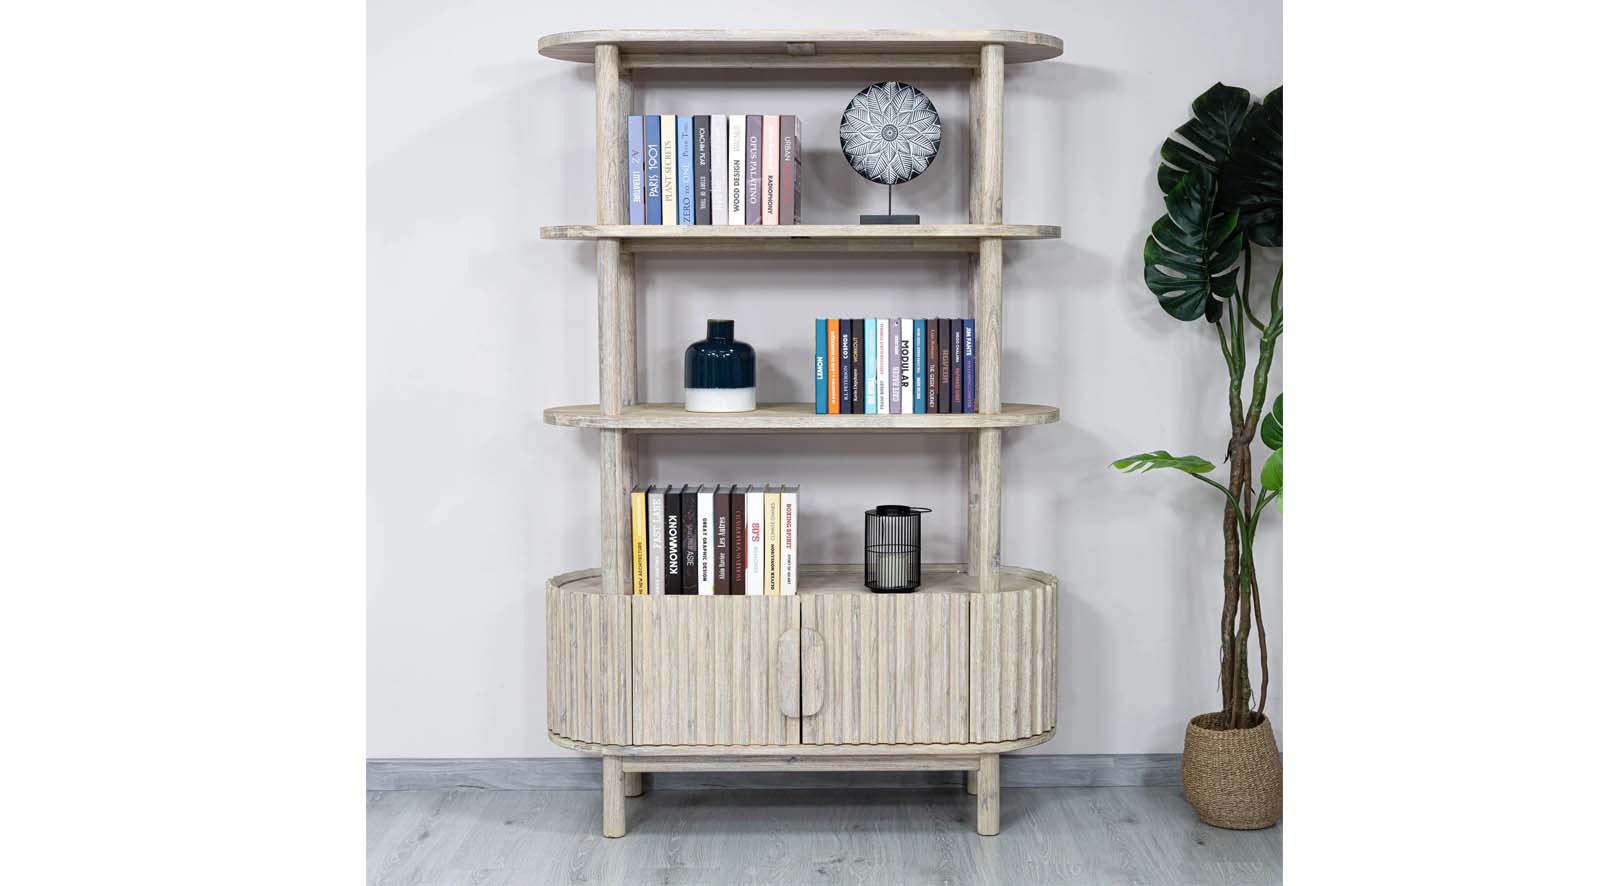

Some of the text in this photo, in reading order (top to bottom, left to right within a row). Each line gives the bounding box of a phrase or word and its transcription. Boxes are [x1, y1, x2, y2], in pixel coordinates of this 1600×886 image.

[784, 137, 792, 161] URBAN
[648, 144, 659, 197] PARIS 1901
[664, 141, 672, 202] PLANT SECRETS
[733, 160, 741, 187] DESIGN
[750, 136, 759, 204] OPUS PALATINO
[682, 198, 691, 223] ZERO
[733, 188, 741, 212] WOOD
[902, 340, 910, 388] MODULAR
[717, 516, 727, 548] Les Autres
[751, 522, 760, 543] 80'S
[686, 550, 694, 566] ASIE
